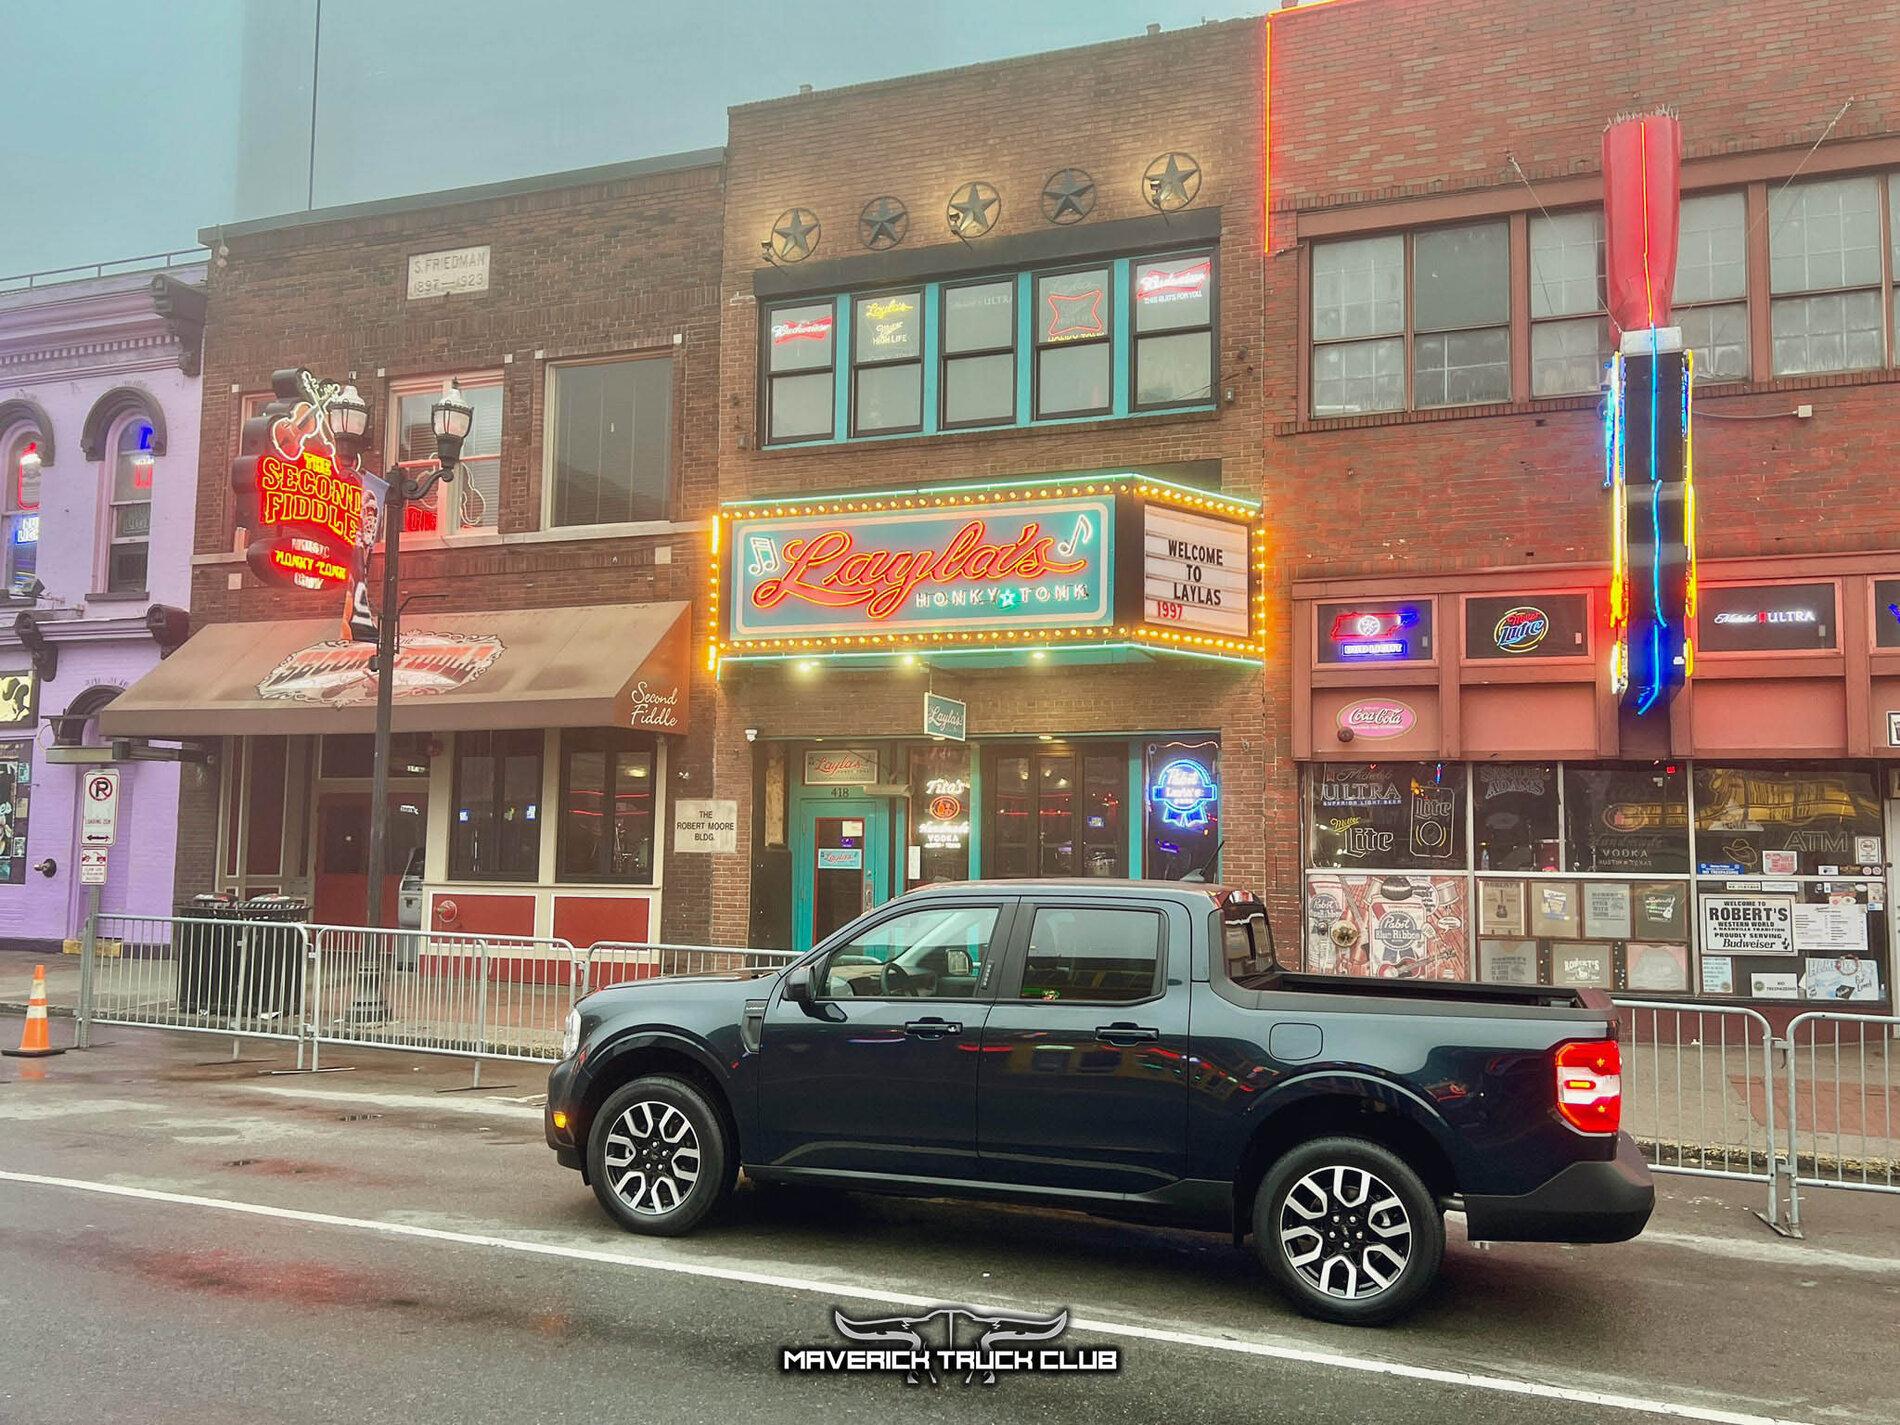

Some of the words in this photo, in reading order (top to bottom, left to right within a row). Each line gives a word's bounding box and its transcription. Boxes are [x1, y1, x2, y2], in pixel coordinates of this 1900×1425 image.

[262, 456, 363, 517] SECOND
[265, 491, 360, 546] FIDDLE
[1168, 539, 1224, 567] WELCOME
[751, 520, 1087, 620] Layla's
[1186, 563, 1202, 583] TO
[915, 589, 1000, 608] HONKY
[1018, 583, 1089, 602] TONK
[1173, 582, 1222, 606] LAYLAS
[1157, 601, 1183, 621] 1997
[1766, 609, 1816, 624] ULTRA
[631, 681, 678, 705] Second
[631, 703, 678, 728] Fiddle
[831, 787, 850, 798] 418
[1321, 781, 1402, 801] ULTRA
[1485, 780, 1545, 799] ADAMS
[699, 811, 713, 819] THE
[1415, 798, 1452, 820] Lite
[676, 822, 705, 830] ROBERT
[708, 822, 734, 831] MOORE
[1330, 816, 1362, 832] Miller
[1344, 827, 1394, 858] Lite
[1783, 830, 1849, 852] ATM
[1603, 849, 1649, 858] VODKA
[1385, 916, 1411, 929] Pabst
[1709, 907, 1789, 922] ROBERT'S
[1722, 939, 1776, 949] Budweiser
